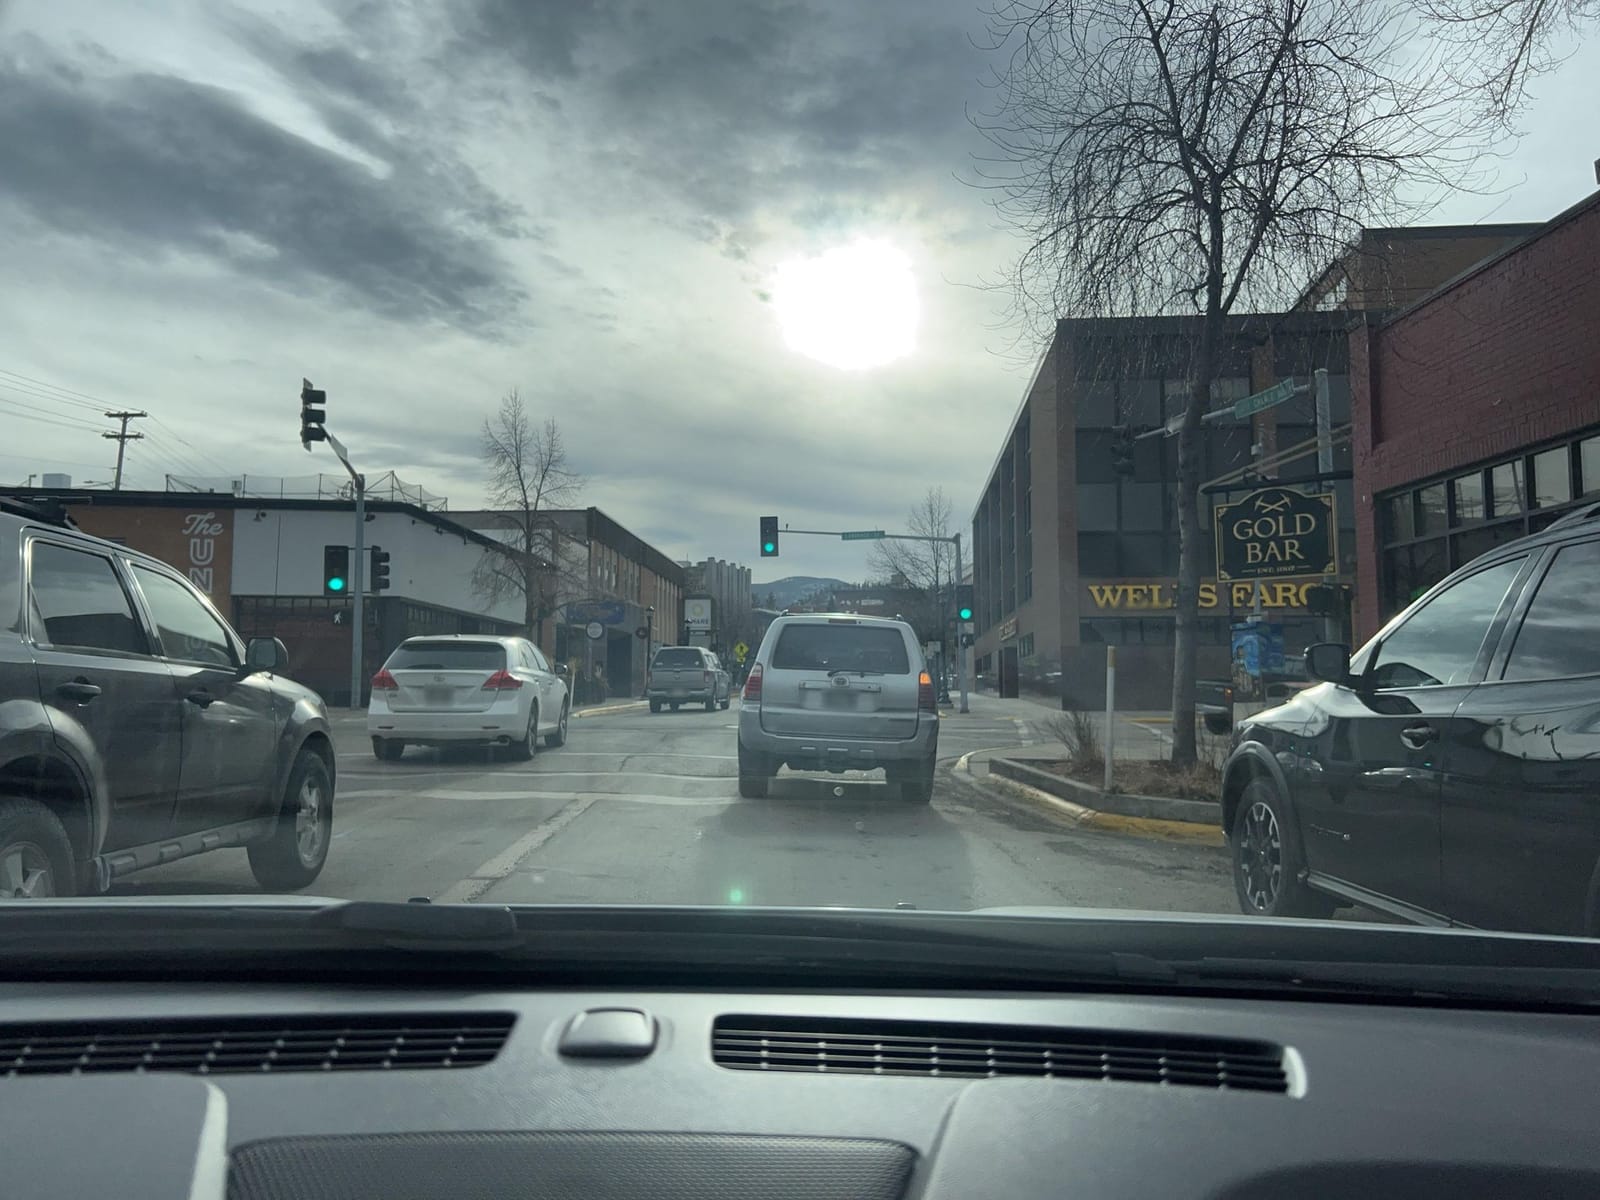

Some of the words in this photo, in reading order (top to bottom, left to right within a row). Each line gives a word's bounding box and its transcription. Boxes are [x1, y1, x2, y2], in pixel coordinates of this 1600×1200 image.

[181, 512, 225, 536] The
[1232, 513, 1316, 540] GOLD
[1246, 539, 1305, 564] BAR
[187, 538, 215, 594] UN
[1088, 583, 1218, 608] WELS
[1231, 582, 1349, 608] FAR
